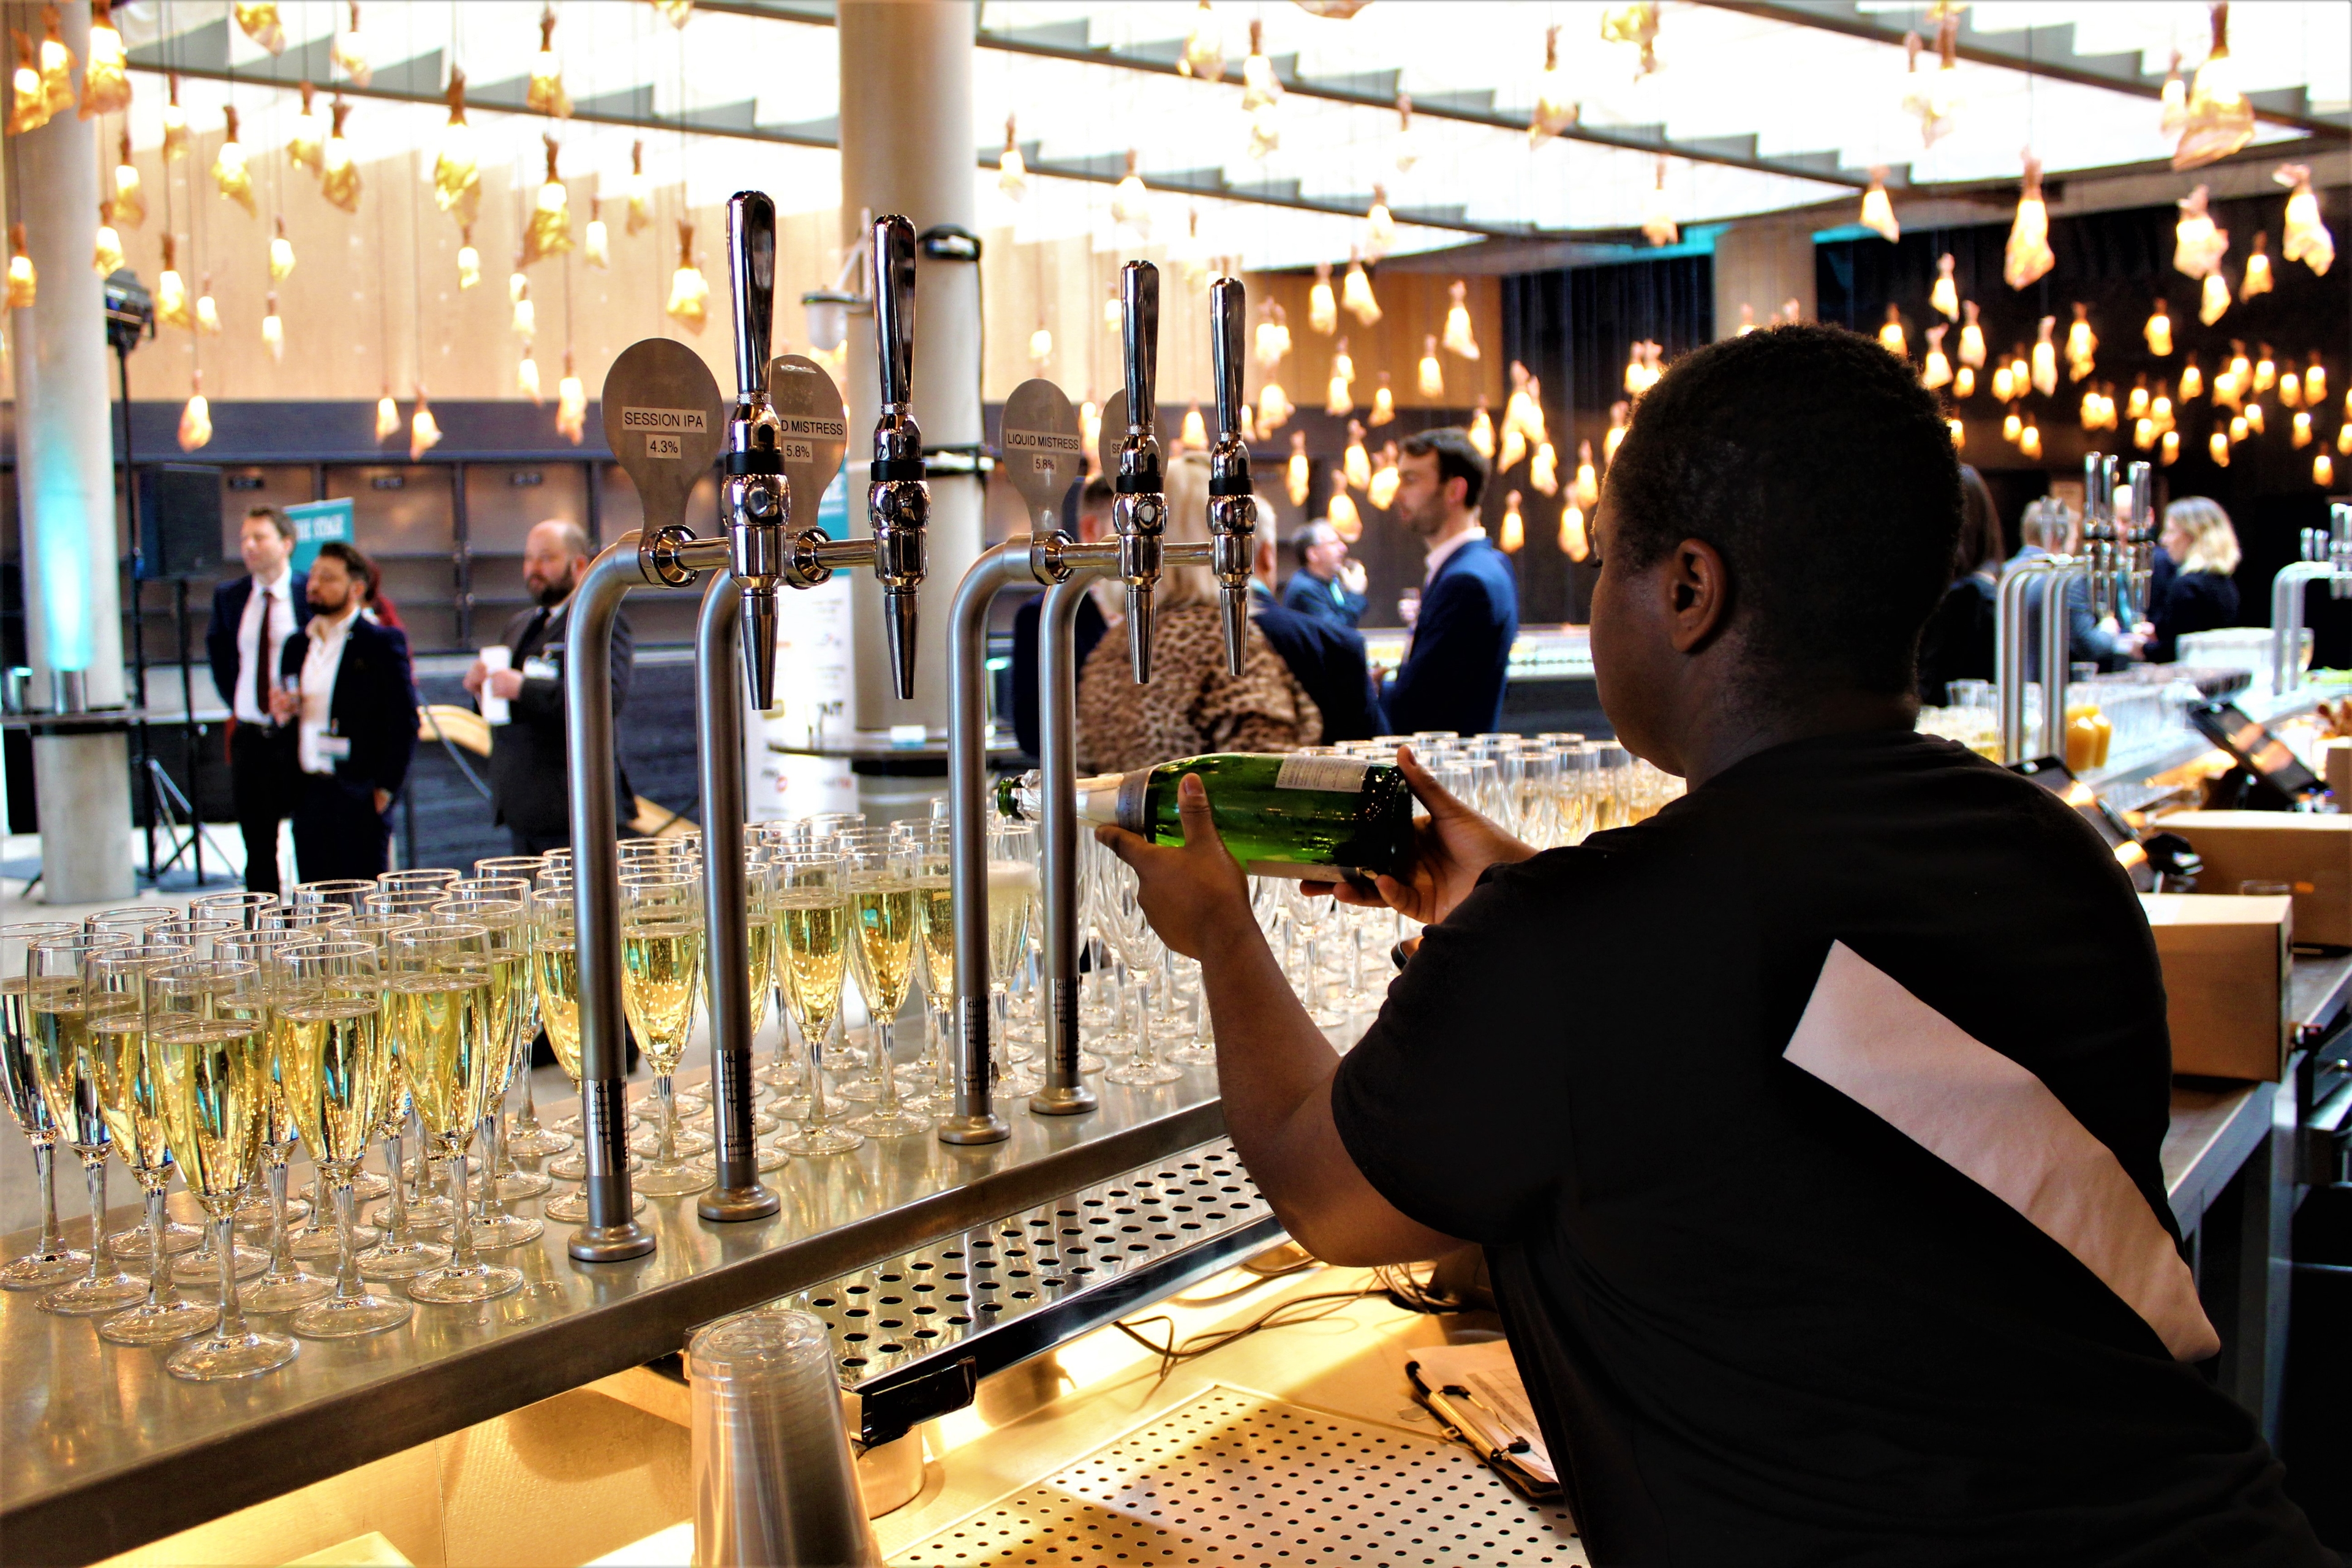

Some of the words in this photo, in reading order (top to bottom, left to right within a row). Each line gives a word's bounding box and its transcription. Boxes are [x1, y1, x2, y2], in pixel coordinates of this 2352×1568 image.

[624, 412, 680, 428] SESSION
[684, 415, 704, 428] IPA
[791, 420, 843, 435] MISTRESS
[649, 439, 679, 454] 4.3%
[1007, 433, 1036, 447] LIQUID
[1038, 435, 1079, 450] MISTRESS
[786, 444, 810, 458] 5.8%
[1035, 458, 1055, 470] 5.8%
